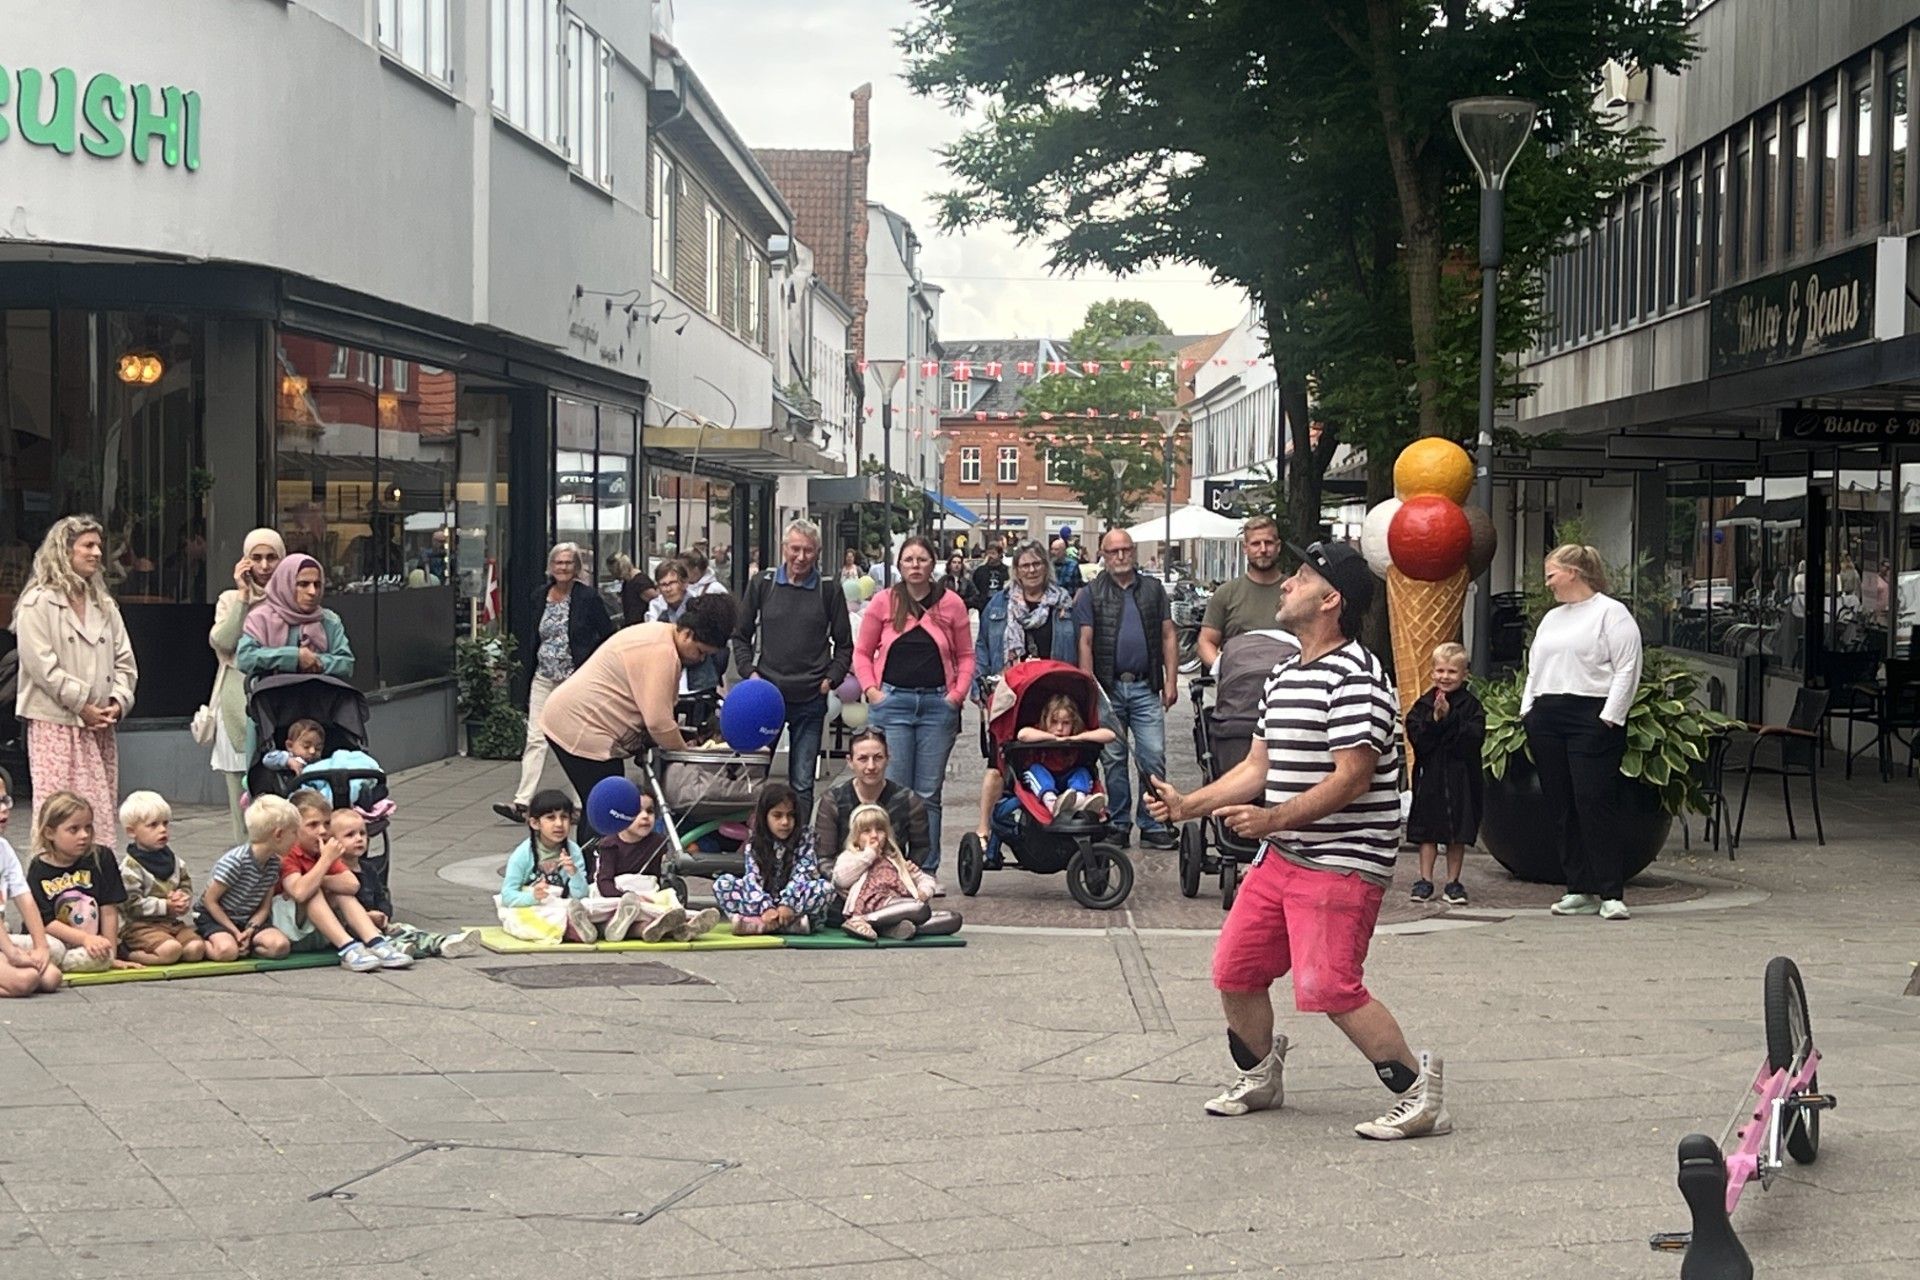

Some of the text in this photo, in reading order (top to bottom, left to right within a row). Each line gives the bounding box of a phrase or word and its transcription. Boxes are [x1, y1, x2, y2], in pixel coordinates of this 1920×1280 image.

[0, 64, 201, 172] USHI
[1738, 273, 1860, 354] Bistro & Beans
[1824, 415, 1877, 433] Bistro
[1885, 417, 1900, 434] &
